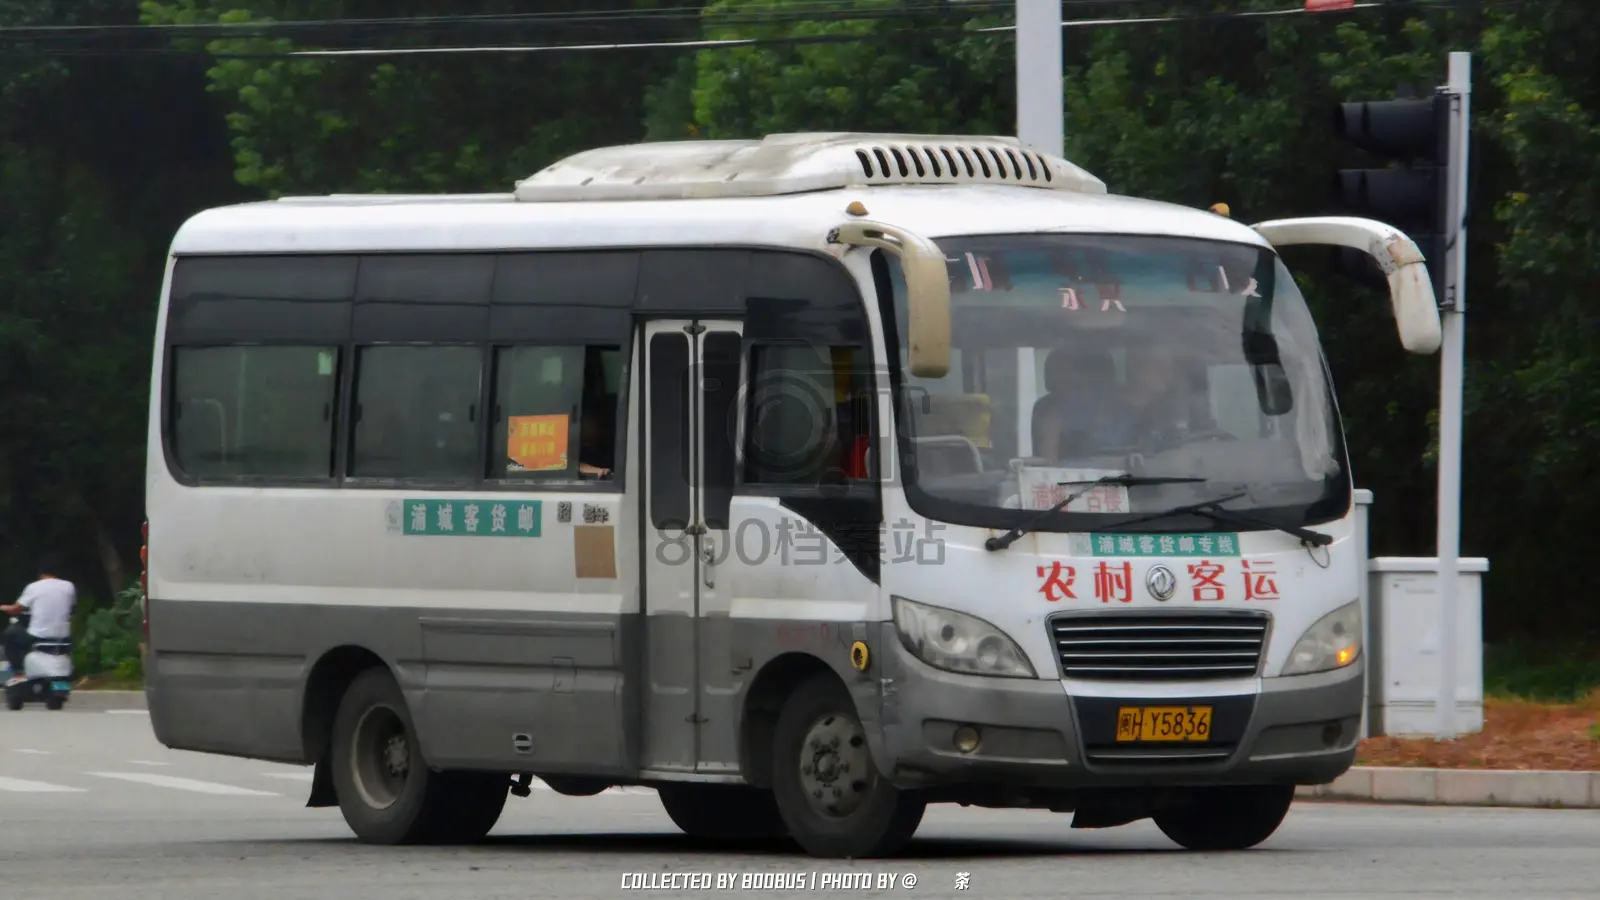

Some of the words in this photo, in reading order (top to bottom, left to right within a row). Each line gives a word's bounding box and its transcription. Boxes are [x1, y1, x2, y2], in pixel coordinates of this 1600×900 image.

[411, 503, 534, 533] 浦城客货邮
[1098, 535, 1235, 555] 浦城客货邮专线
